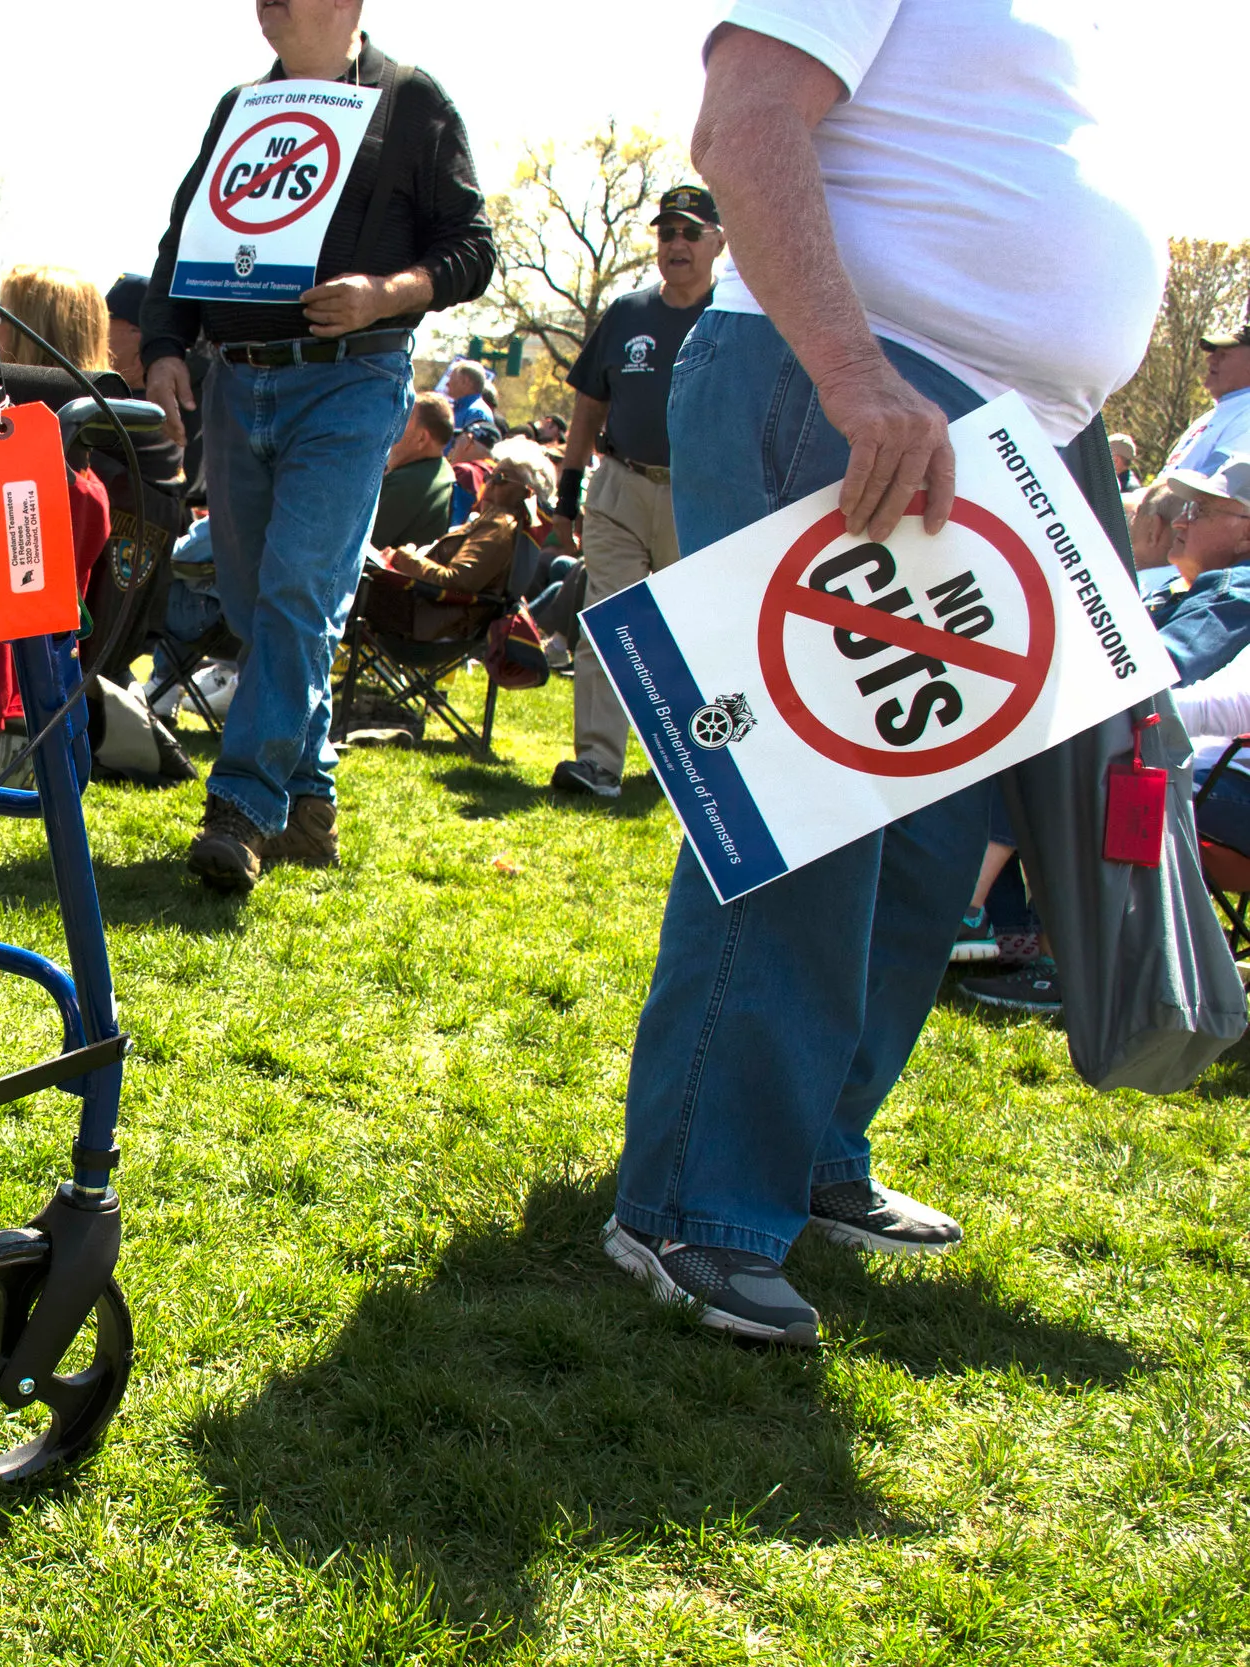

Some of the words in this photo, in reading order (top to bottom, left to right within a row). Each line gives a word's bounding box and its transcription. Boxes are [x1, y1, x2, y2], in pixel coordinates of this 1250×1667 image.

[243, 94, 284, 107] PROTECT
[285, 93, 307, 104] OUR
[307, 94, 363, 109] PENSIONS
[265, 137, 297, 158] NO
[223, 163, 318, 201] CUTS
[185, 278, 223, 288] International
[224, 280, 261, 290] Brotherhood
[262, 281, 269, 290] of
[270, 281, 301, 291] Teamsters
[7, 491, 15, 530] Teamsters
[30, 513, 37, 525] OH
[9, 531, 18, 566] Cleveland
[24, 516, 32, 547] Superior
[32, 526, 40, 564] Cleveland,
[988, 428, 1056, 520] PROTECT
[1045, 522, 1081, 571] OUR
[1070, 568, 1137, 680] PENSIONS
[925, 570, 994, 640] NO
[809, 542, 963, 746] CUTS
[615, 625, 665, 705] International
[655, 705, 704, 784] Brotherhood
[694, 779, 712, 800] of
[702, 799, 742, 866] Teamsters
